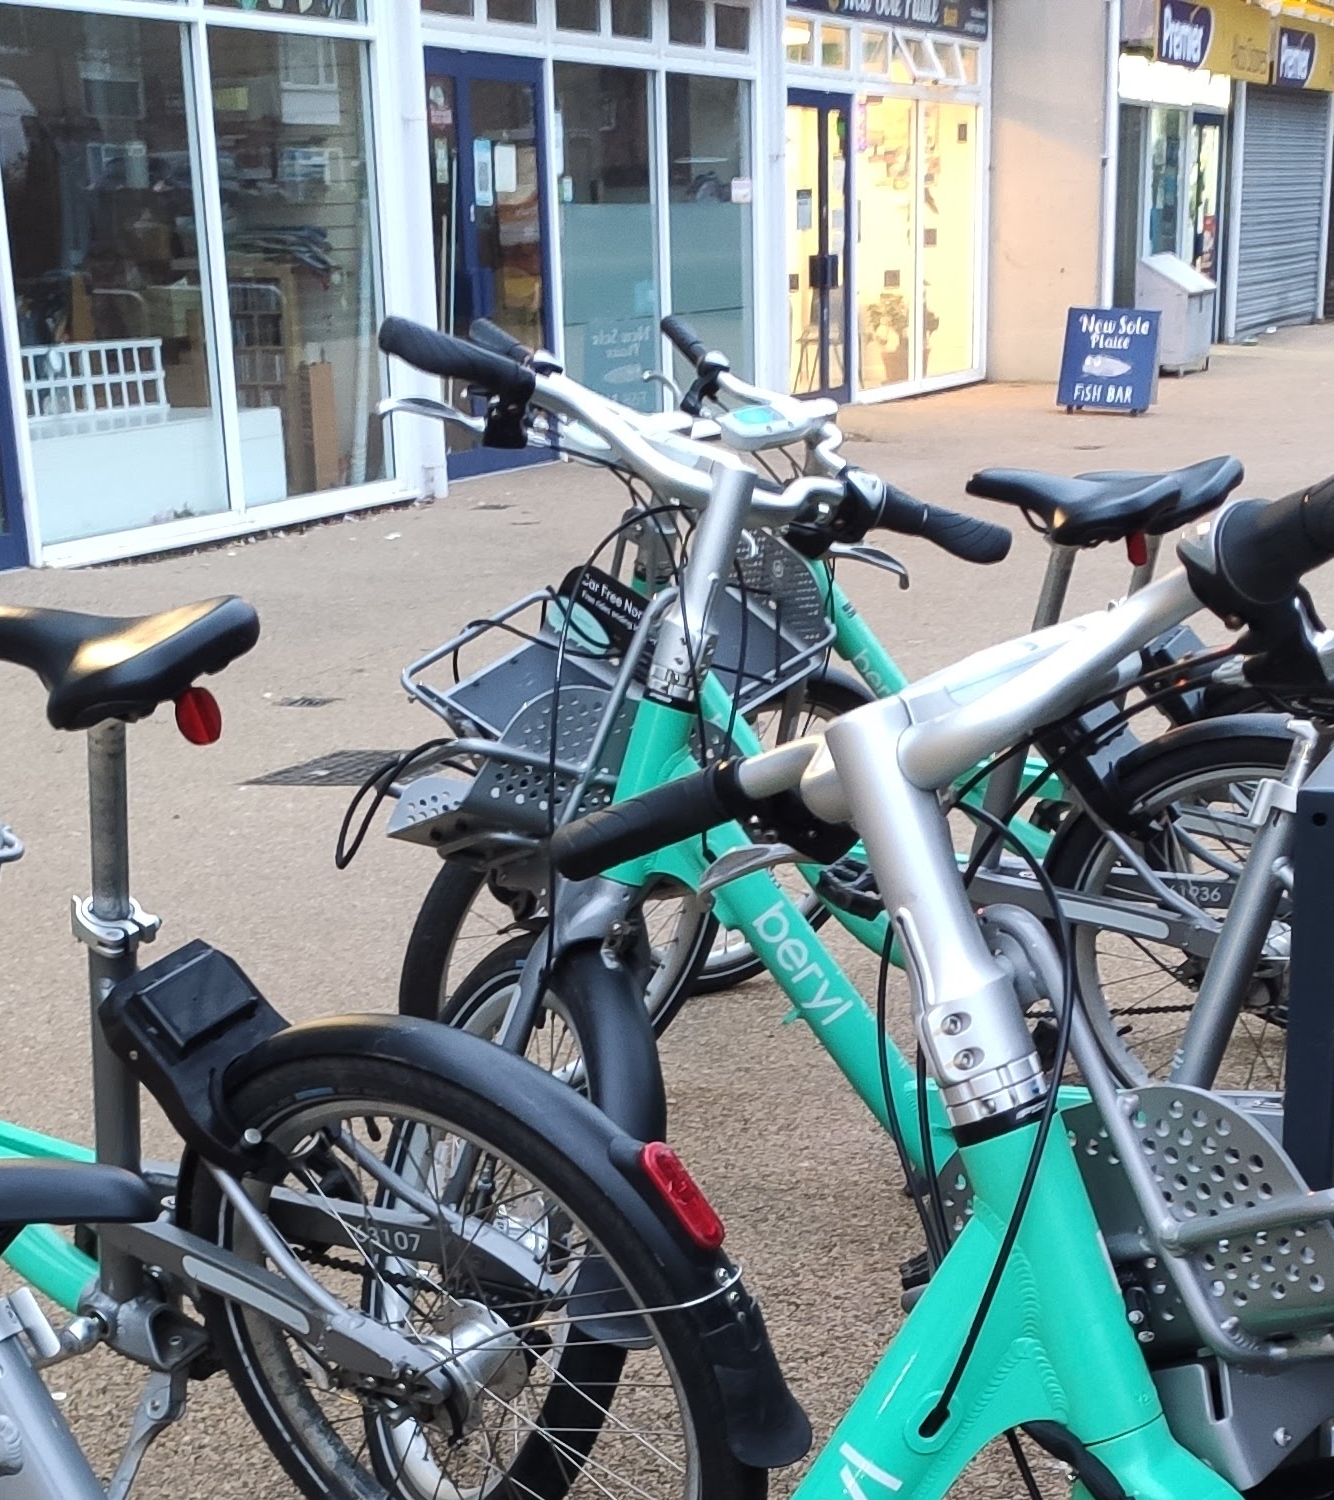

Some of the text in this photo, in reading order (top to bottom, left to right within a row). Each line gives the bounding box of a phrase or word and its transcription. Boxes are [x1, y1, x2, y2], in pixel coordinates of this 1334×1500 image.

[1161, 4, 1204, 63] Premier
[1280, 32, 1311, 80] Premier
[1079, 314, 1150, 335] New Sole
[1090, 333, 1131, 349] Plaice
[1106, 384, 1133, 404] BAR
[601, 584, 622, 607] Free
[624, 598, 644, 620] Nor
[1170, 884, 1222, 902] 1936
[752, 901, 854, 1026] beryl
[354, 1224, 421, 1252] 63107
